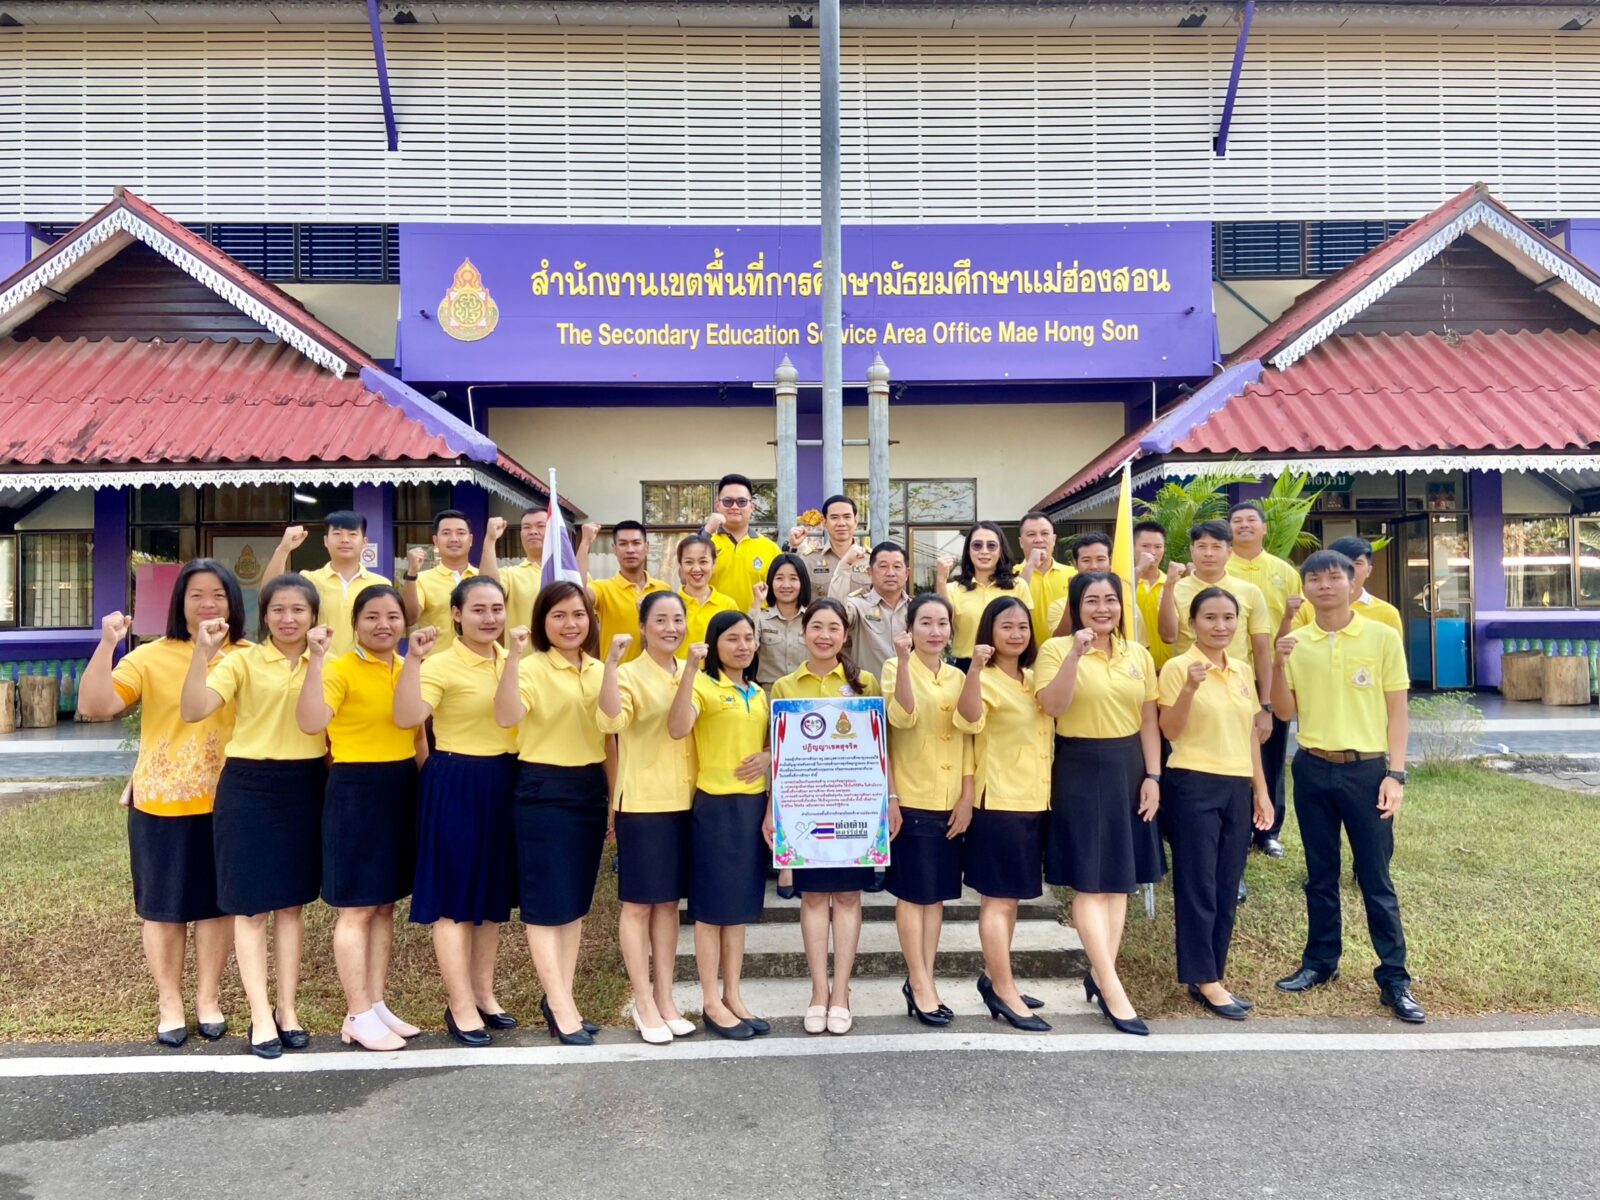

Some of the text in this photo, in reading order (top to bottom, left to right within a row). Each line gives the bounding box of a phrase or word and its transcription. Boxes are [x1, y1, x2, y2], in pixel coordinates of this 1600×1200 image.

[556, 319, 1139, 350] The Secondary Education Svice Area Office Mae Hong Son
